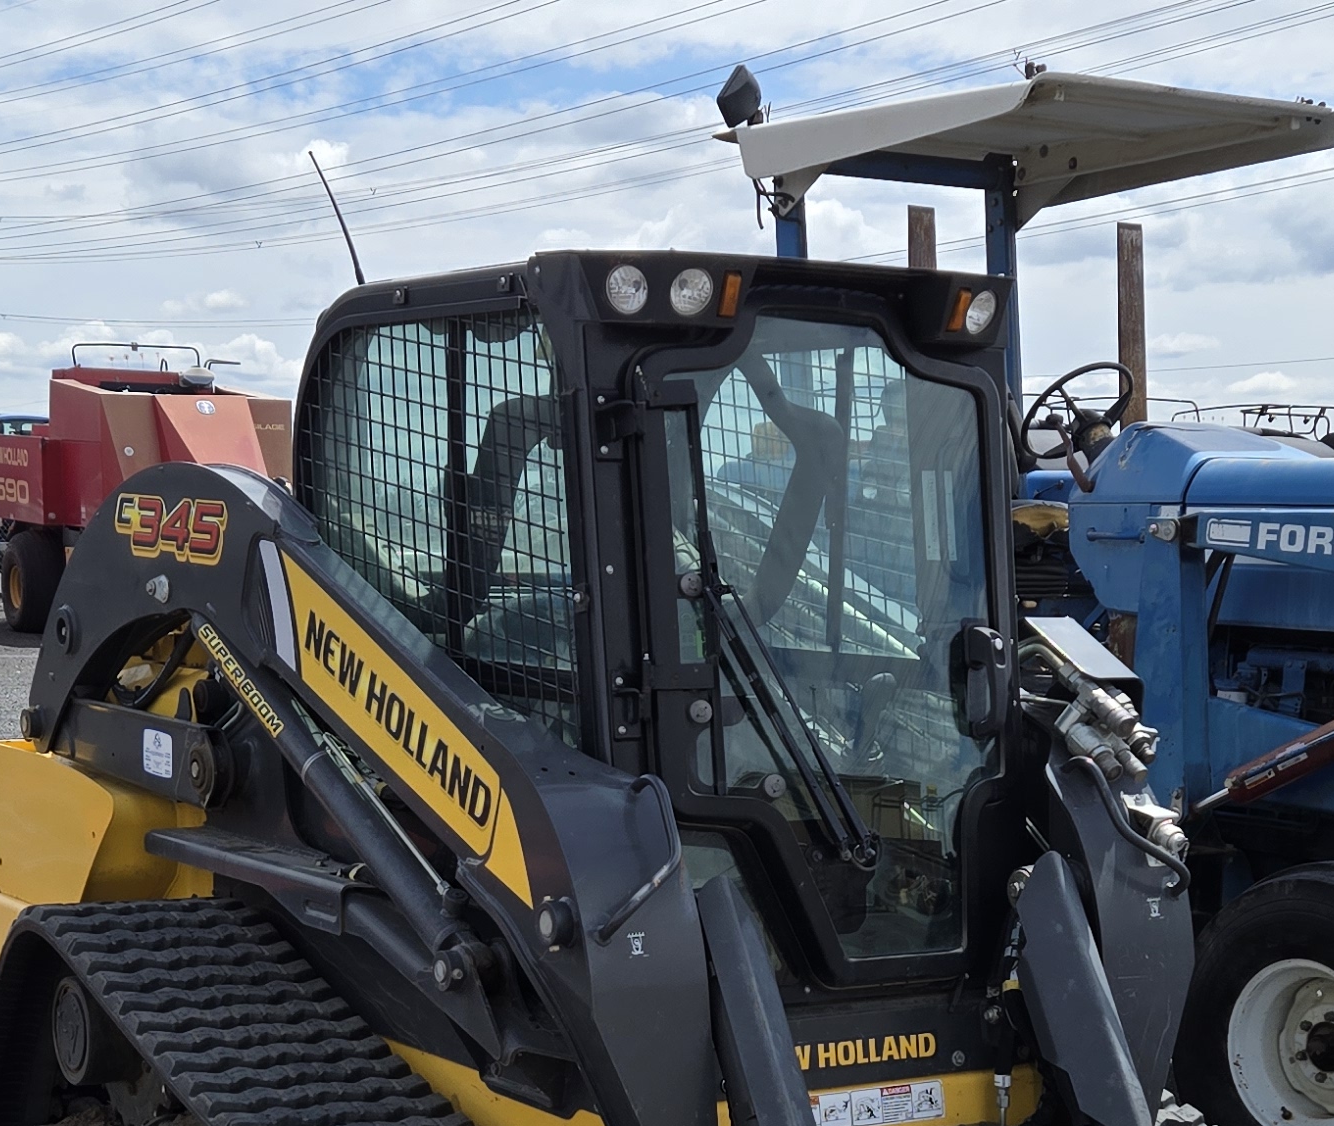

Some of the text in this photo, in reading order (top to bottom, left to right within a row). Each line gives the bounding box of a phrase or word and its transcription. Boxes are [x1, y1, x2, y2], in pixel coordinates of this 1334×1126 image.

[4, 447, 29, 467] HOLLAND
[115, 493, 228, 566] C345
[198, 623, 285, 738] SUPER BOOM
[305, 609, 492, 828] NEW HOLLAND
[818, 1032, 937, 1068] HOLLAND
